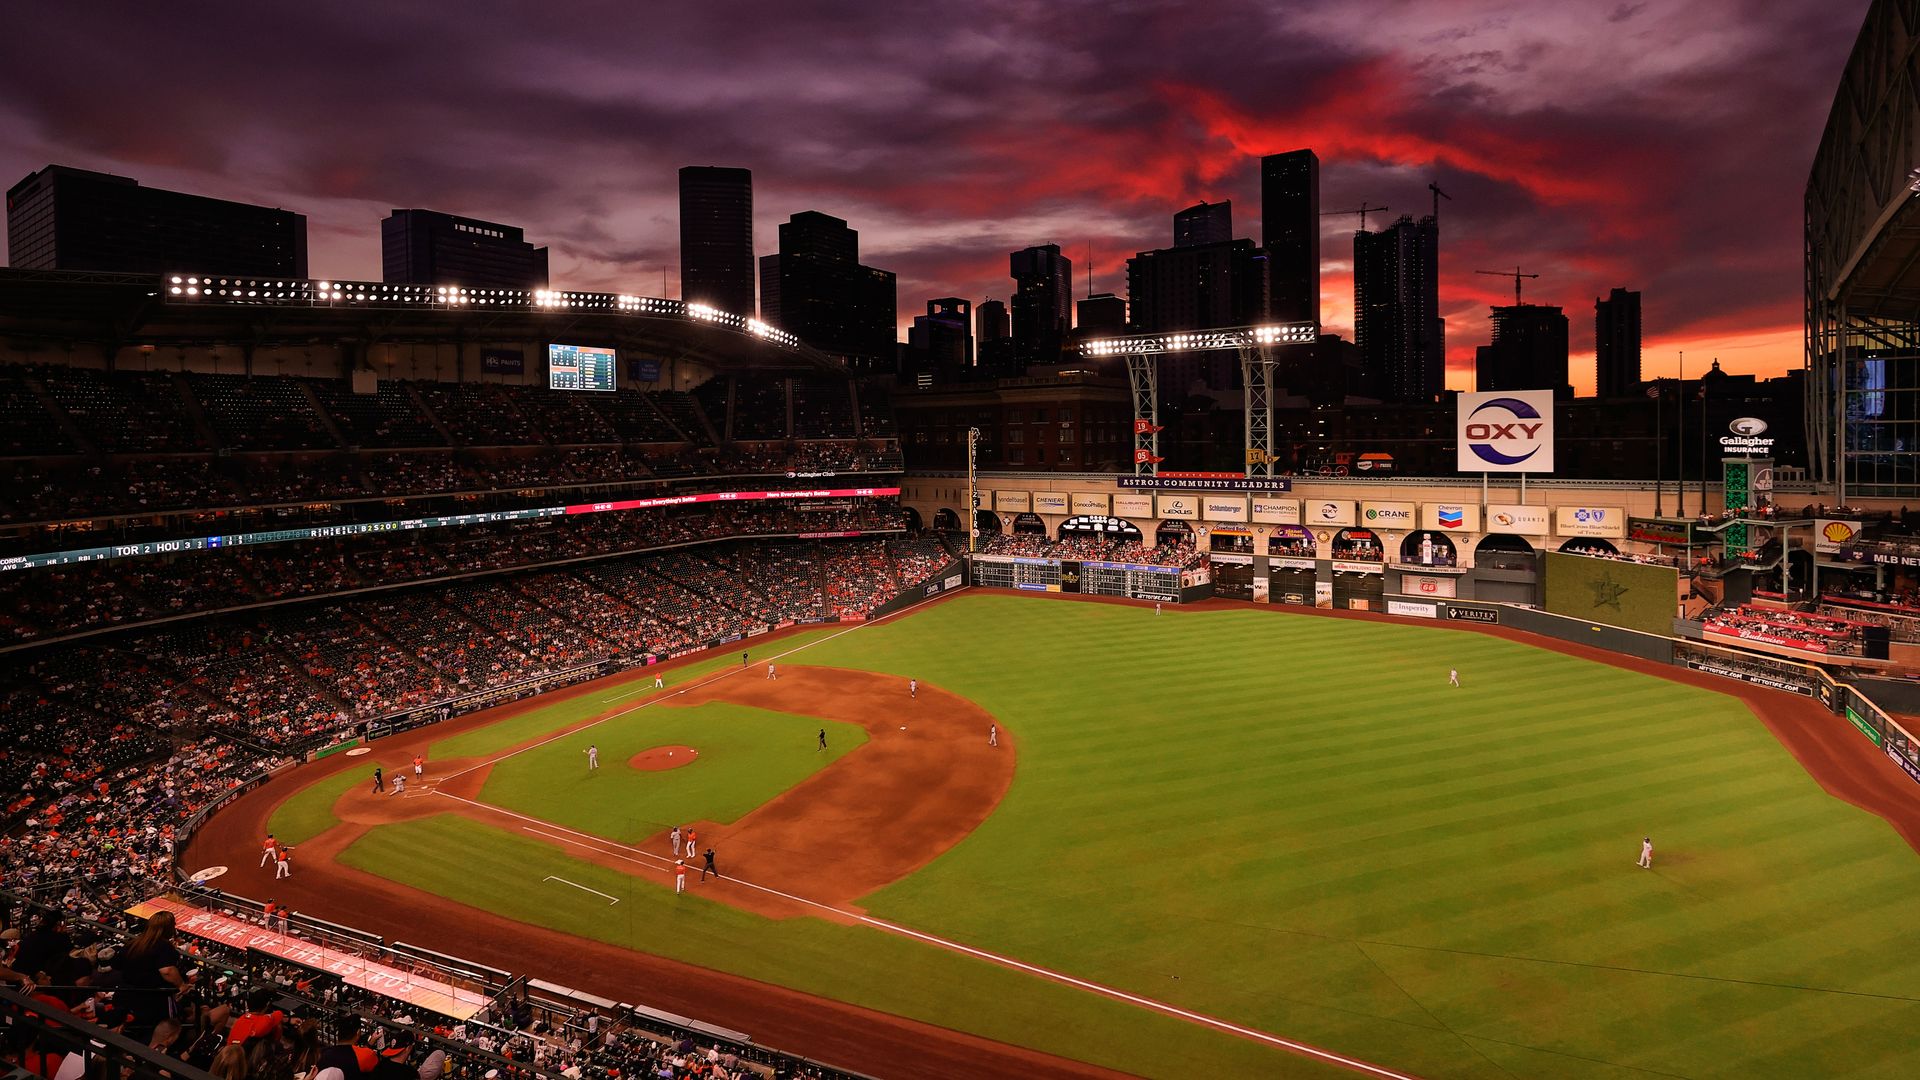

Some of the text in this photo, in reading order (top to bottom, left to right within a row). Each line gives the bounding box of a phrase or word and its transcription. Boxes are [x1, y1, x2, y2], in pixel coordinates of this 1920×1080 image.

[1466, 423, 1543, 440] OXY
[1720, 437, 1774, 446] Gallagher
[1250, 452, 1259, 460] 17
[1209, 505, 1241, 513] Schlumberger
[116, 546, 138, 556] TOR
[157, 542, 179, 552] HOU
[1874, 554, 1920, 566] MLB NET
[1398, 604, 1429, 612] Insperity
[1459, 610, 1494, 618] VERITEX
[1740, 628, 1785, 644] Budweiser
[1698, 665, 1798, 692] NITTOTIRE.COM NITTOTIRE.COM
[218, 792, 237, 810] H-E-B
[249, 936, 281, 948] OF
[282, 946, 322, 963] THE
[326, 960, 414, 992] ASTROS
